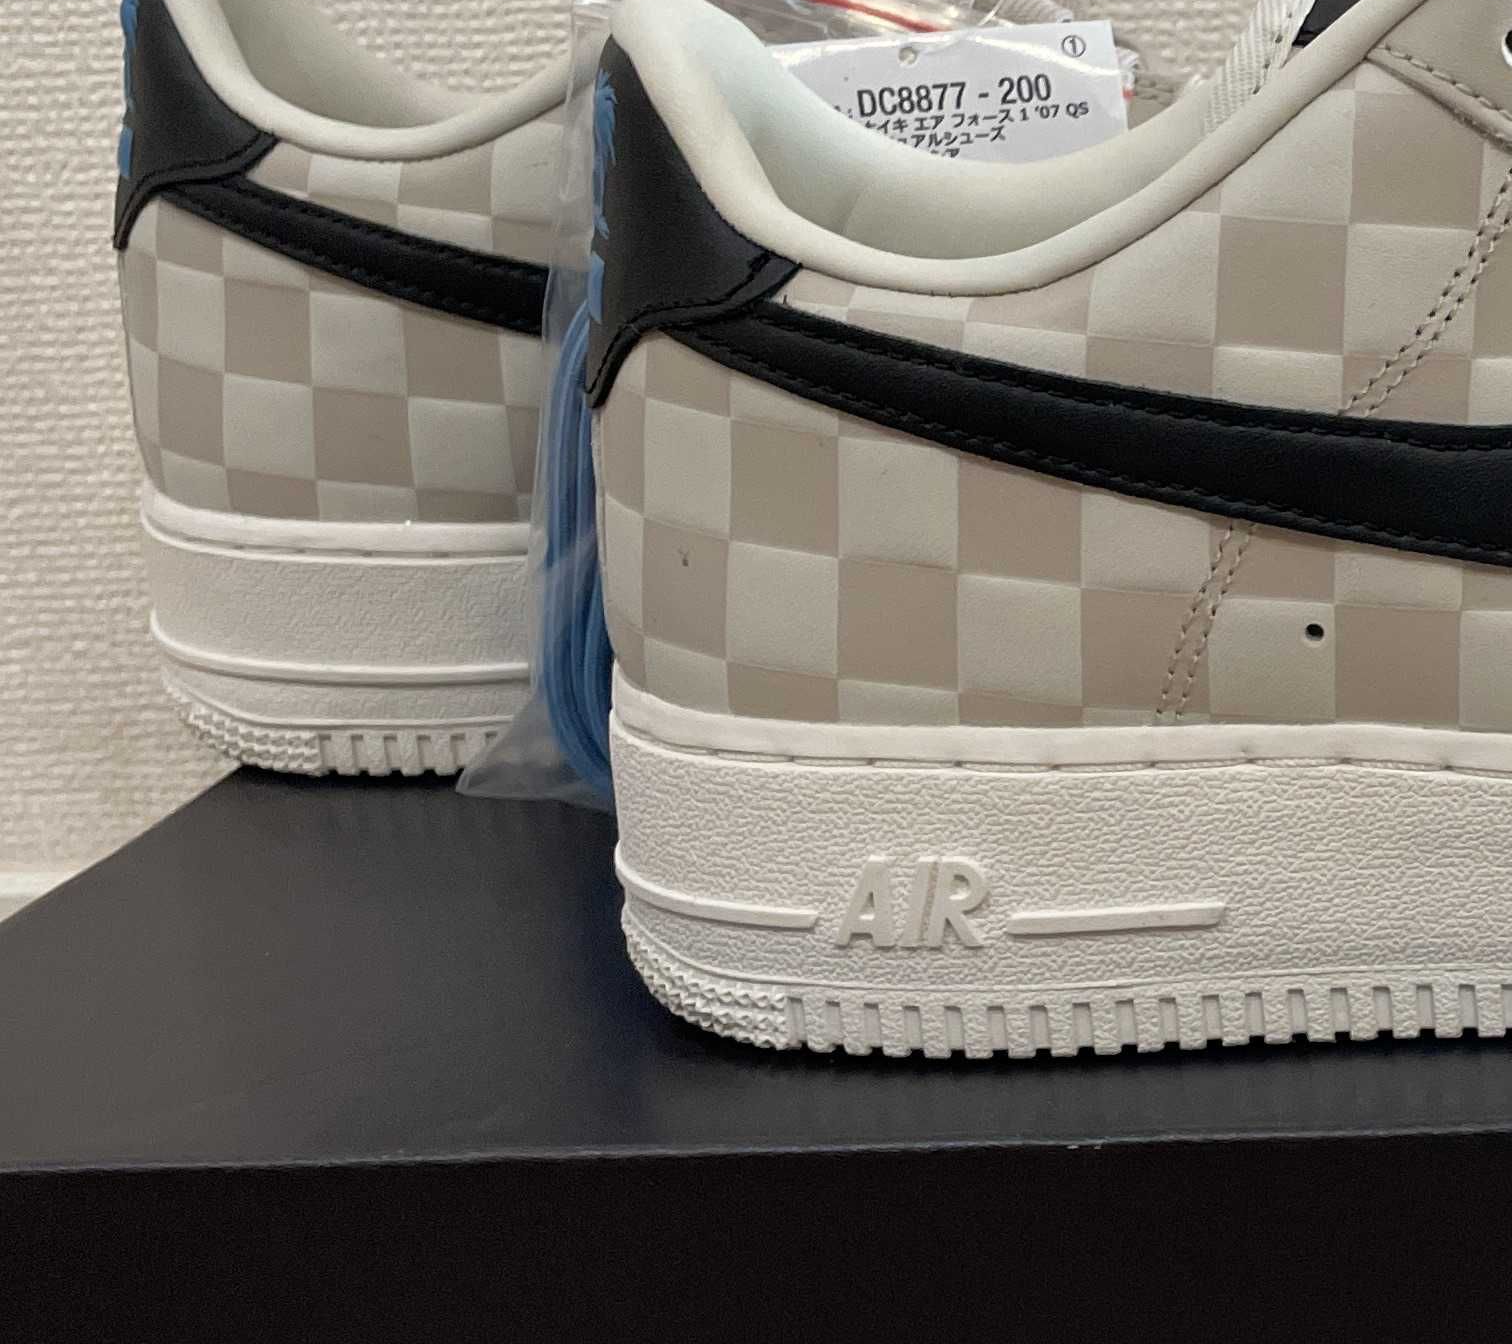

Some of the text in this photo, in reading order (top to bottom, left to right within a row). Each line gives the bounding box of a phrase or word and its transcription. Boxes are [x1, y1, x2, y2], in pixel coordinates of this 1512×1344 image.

[856, 81, 966, 118] DC8877
[998, 73, 1051, 105] 200
[913, 114, 945, 131] エア
[951, 108, 1015, 129] フォース
[1019, 107, 1029, 122] 1
[1065, 101, 1089, 119] QS
[889, 124, 1006, 149] アルシューズ
[834, 854, 992, 949] AIR
